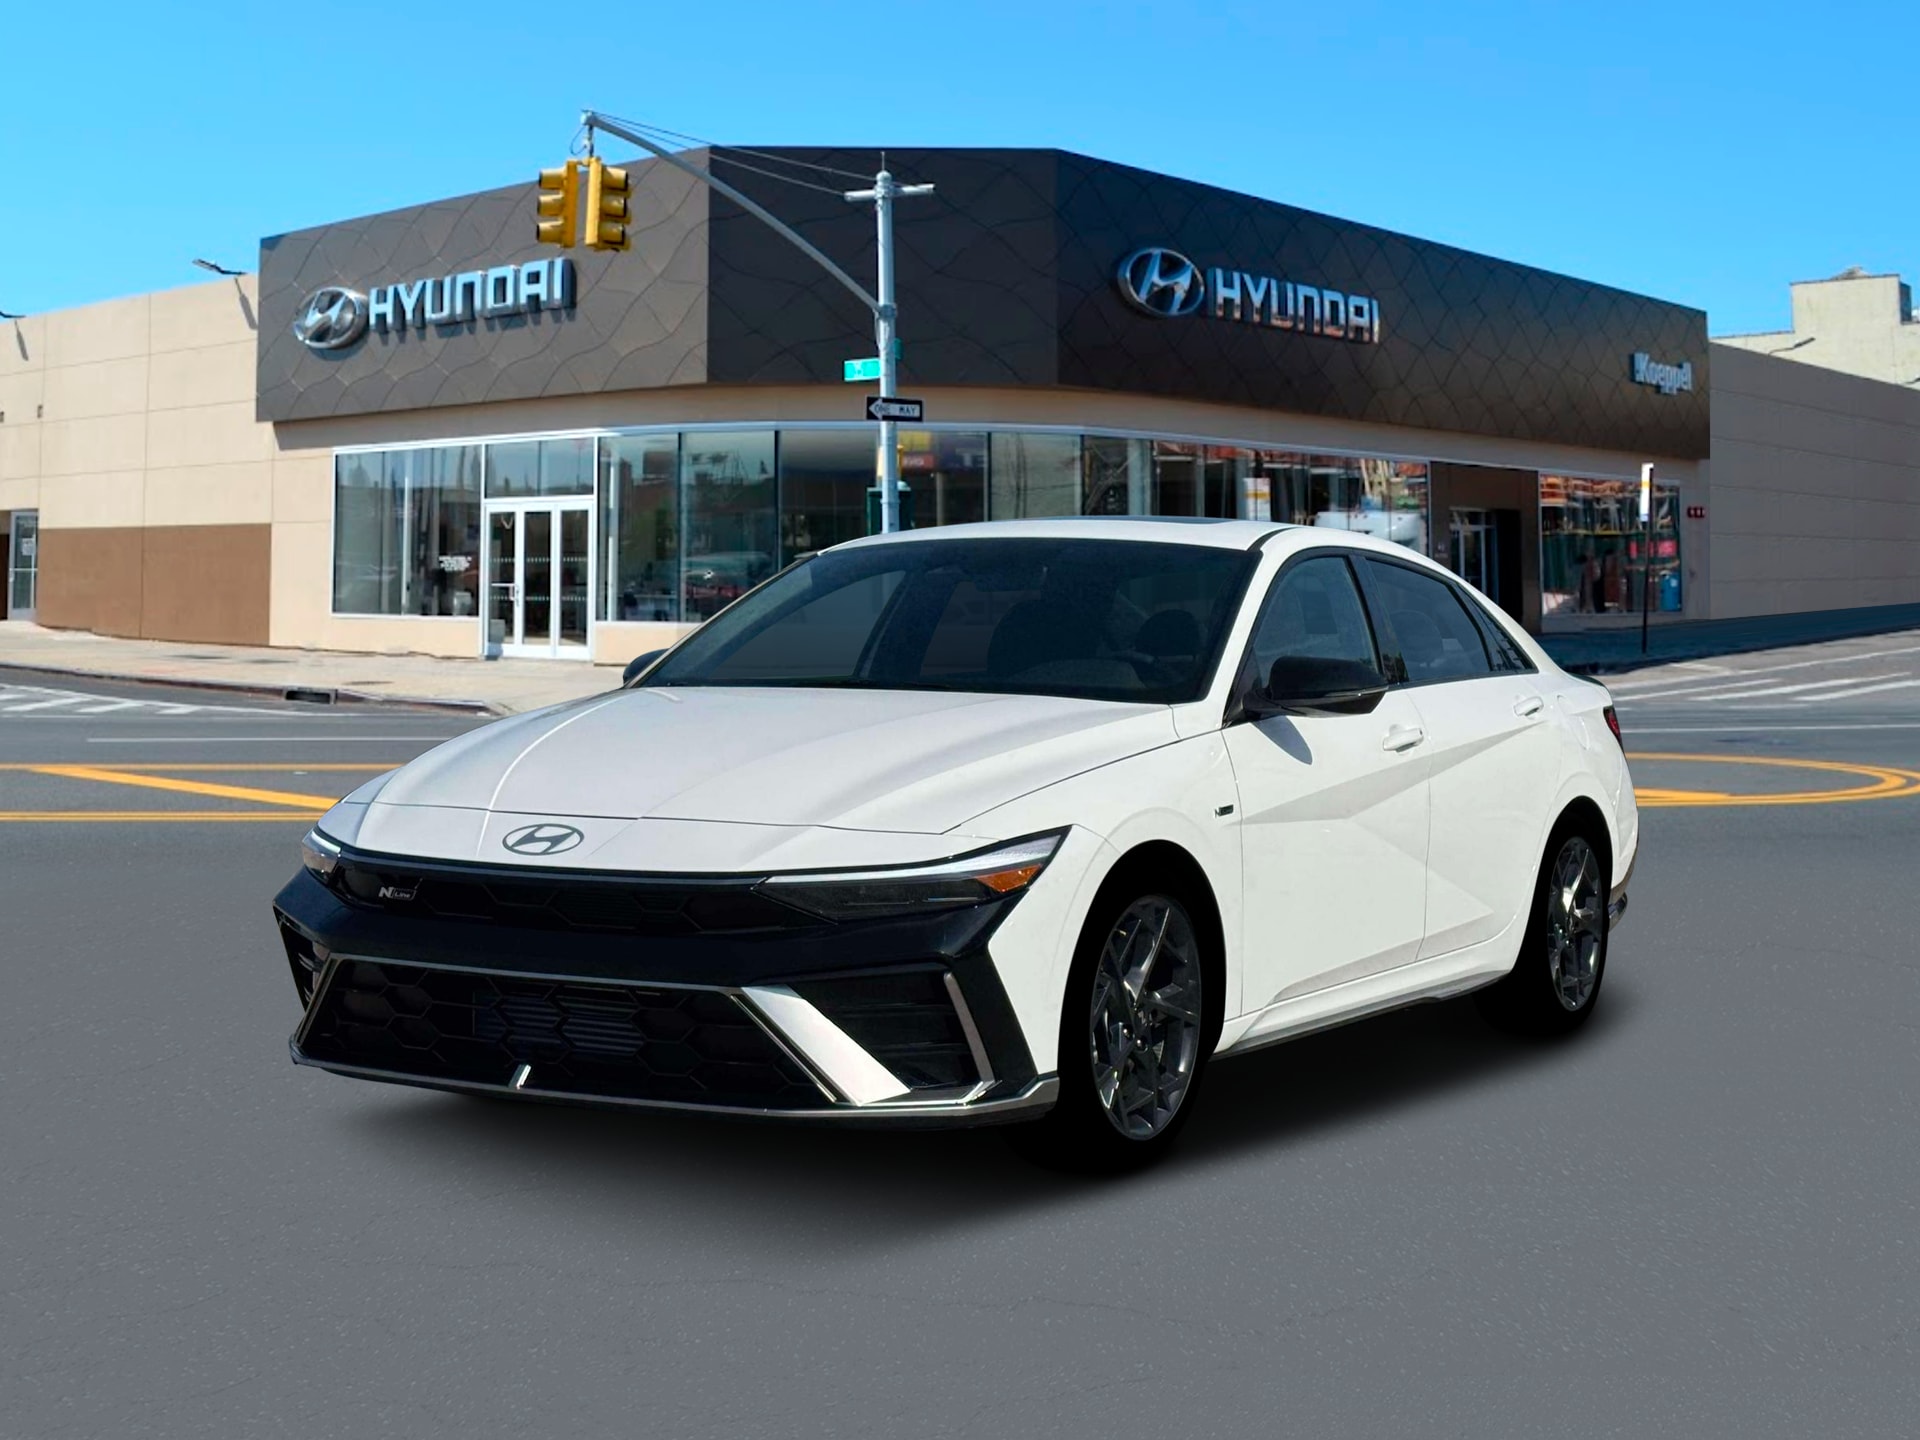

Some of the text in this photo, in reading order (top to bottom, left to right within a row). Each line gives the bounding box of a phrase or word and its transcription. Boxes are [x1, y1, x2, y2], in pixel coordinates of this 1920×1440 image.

[368, 257, 573, 331] HYUNDAI
[1210, 267, 1381, 344] HYUNDAI
[1633, 352, 1693, 395] Koeppel
[874, 404, 916, 416] ONE WAY
